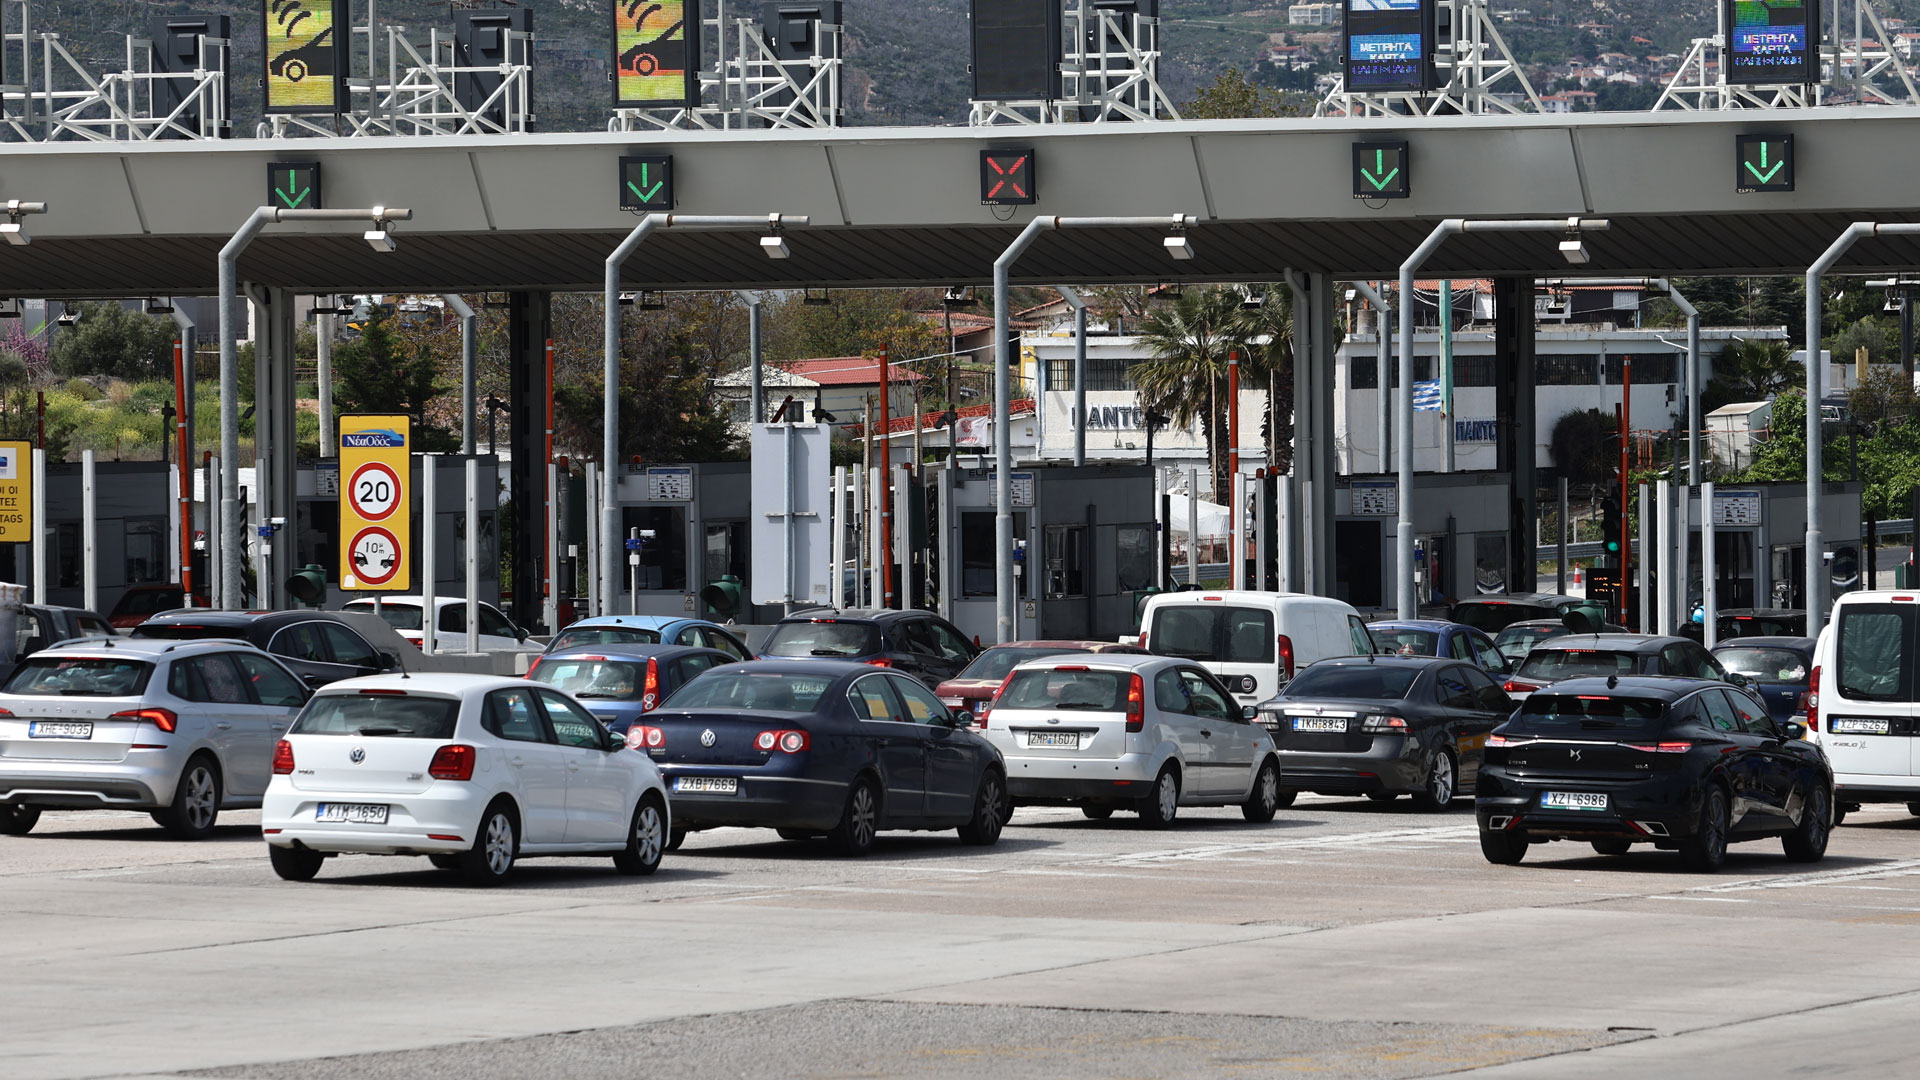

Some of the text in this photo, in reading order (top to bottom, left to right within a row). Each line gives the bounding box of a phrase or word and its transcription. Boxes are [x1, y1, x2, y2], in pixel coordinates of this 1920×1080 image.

[1743, 34, 1798, 44] ΜΕΤΡΗΤΑ
[1360, 42, 1414, 52] ΜΕΤΡΗΤΑ
[1752, 44, 1792, 54] ΚΑΡΤΑ
[1456, 420, 1497, 442] ΠΑΝΤΟ
[360, 481, 390, 503] 20
[0, 498, 17, 506] ΤΕΣ
[365, 541, 378, 554] 10
